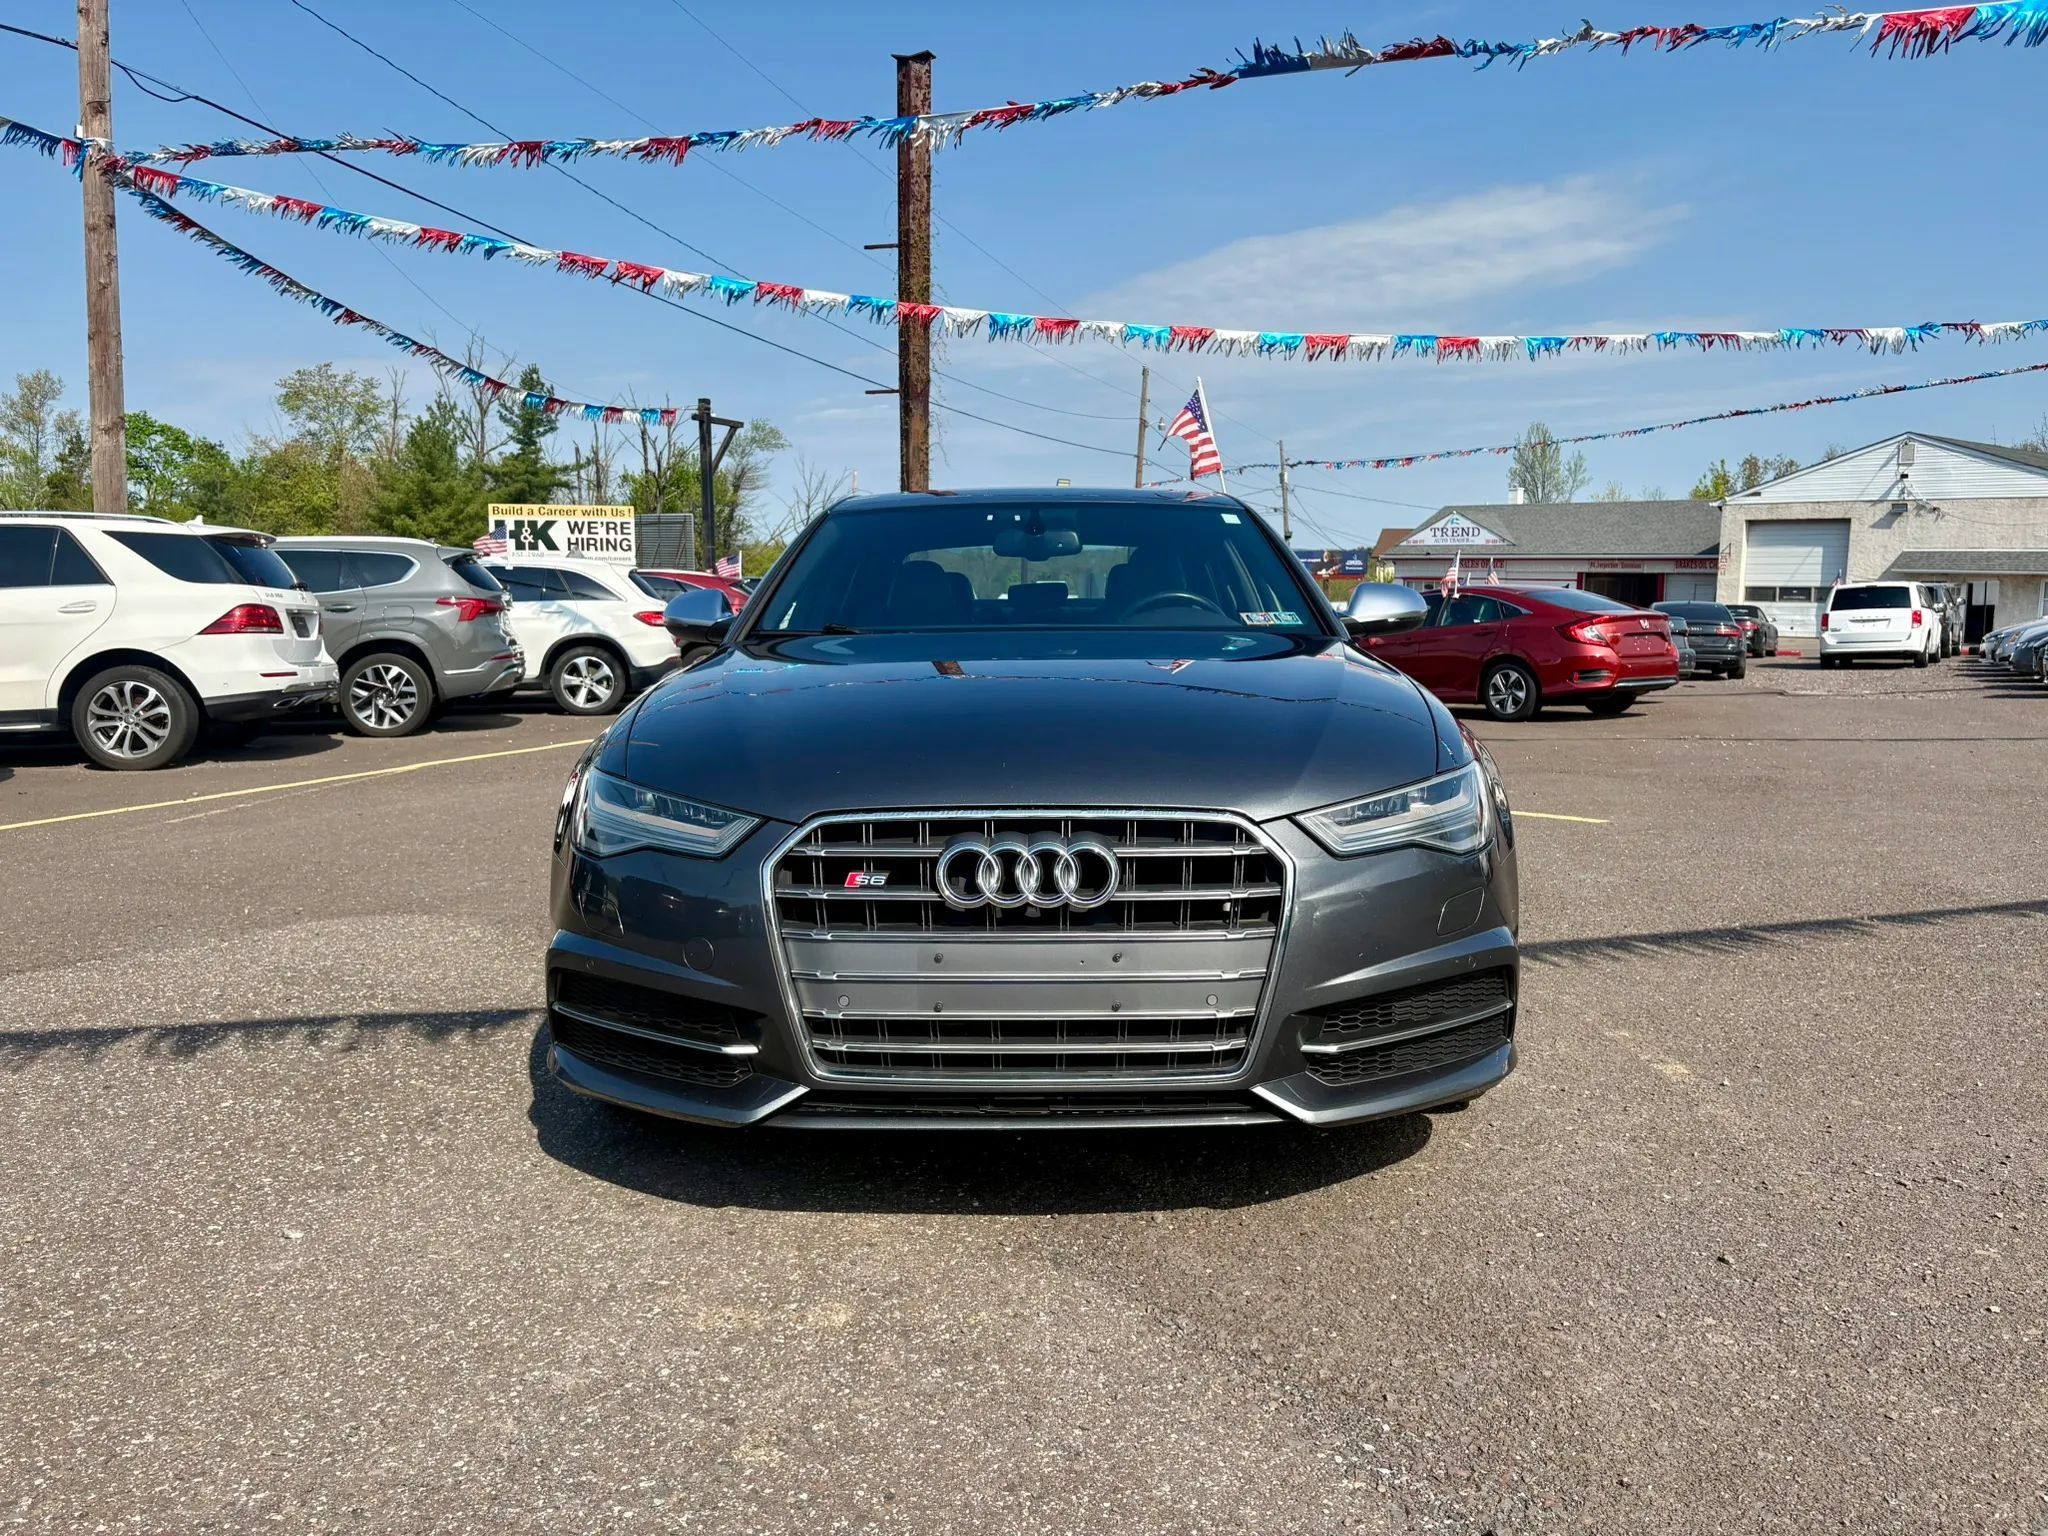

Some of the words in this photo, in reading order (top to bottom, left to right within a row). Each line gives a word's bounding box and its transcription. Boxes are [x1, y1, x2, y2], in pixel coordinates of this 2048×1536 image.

[492, 506, 523, 516] Build
[527, 508, 534, 516] a
[538, 506, 578, 517] Career
[581, 506, 607, 517] with
[567, 520, 632, 536] WE'RE
[1430, 526, 1481, 538] TREND
[494, 519, 561, 551] H&K
[567, 537, 632, 553] HIRING
[1459, 559, 1479, 569] SALES
[1480, 559, 1505, 569] OFICE
[1676, 559, 1697, 569] BRAKES
[853, 875, 887, 886] S6
